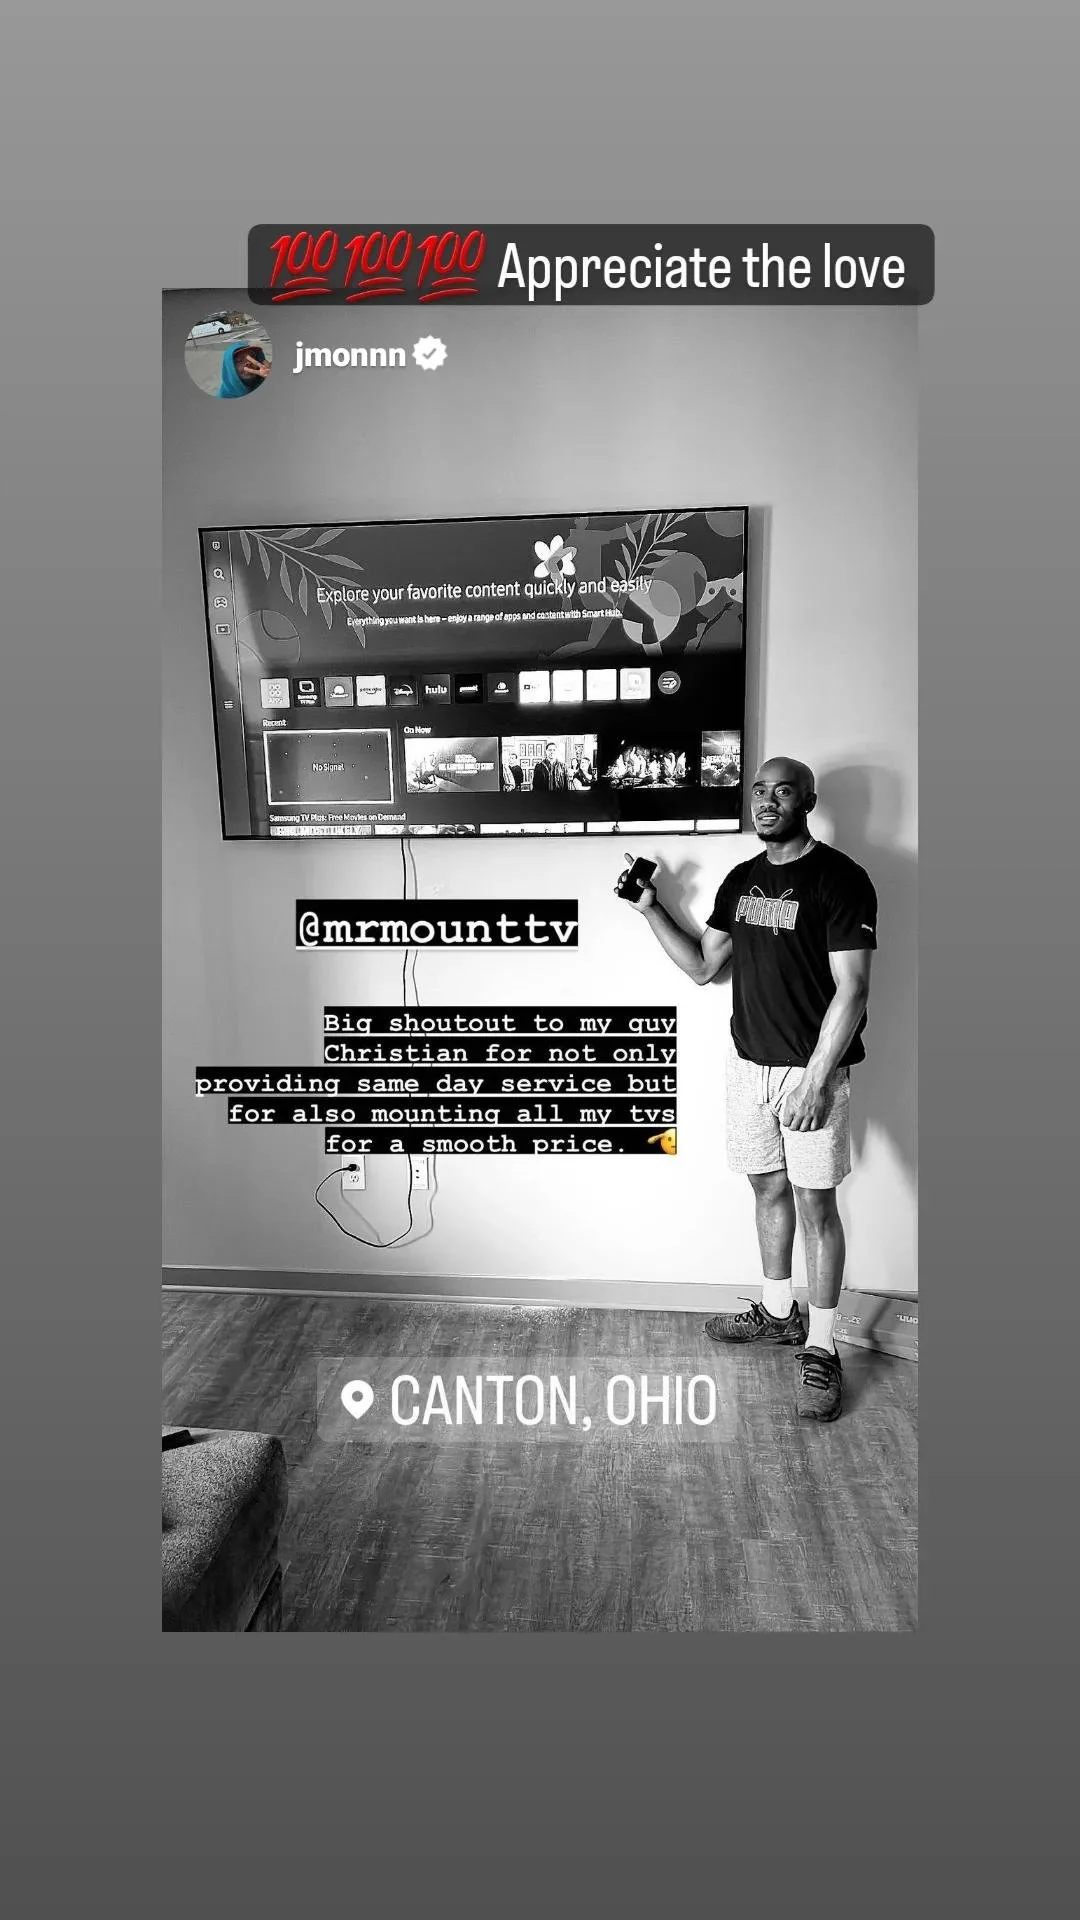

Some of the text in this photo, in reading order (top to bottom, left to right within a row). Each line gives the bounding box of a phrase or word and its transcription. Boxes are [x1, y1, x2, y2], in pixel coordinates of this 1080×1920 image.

[317, 575, 653, 604] Explore your favorite content quickly and easily
[347, 617, 384, 626] Everything
[399, 616, 416, 624] want
[424, 615, 440, 623] here
[448, 615, 467, 623] enjoy
[474, 615, 494, 624] range
[495, 612, 503, 620] of
[522, 612, 535, 620] and
[537, 611, 564, 620] content
[564, 610, 581, 618] with
[582, 610, 604, 618] Smart
[425, 685, 447, 694] hulu
[415, 726, 431, 734] Now
[324, 763, 344, 772] Signal
[344, 813, 367, 821] Movies
[378, 812, 406, 821] Demand
